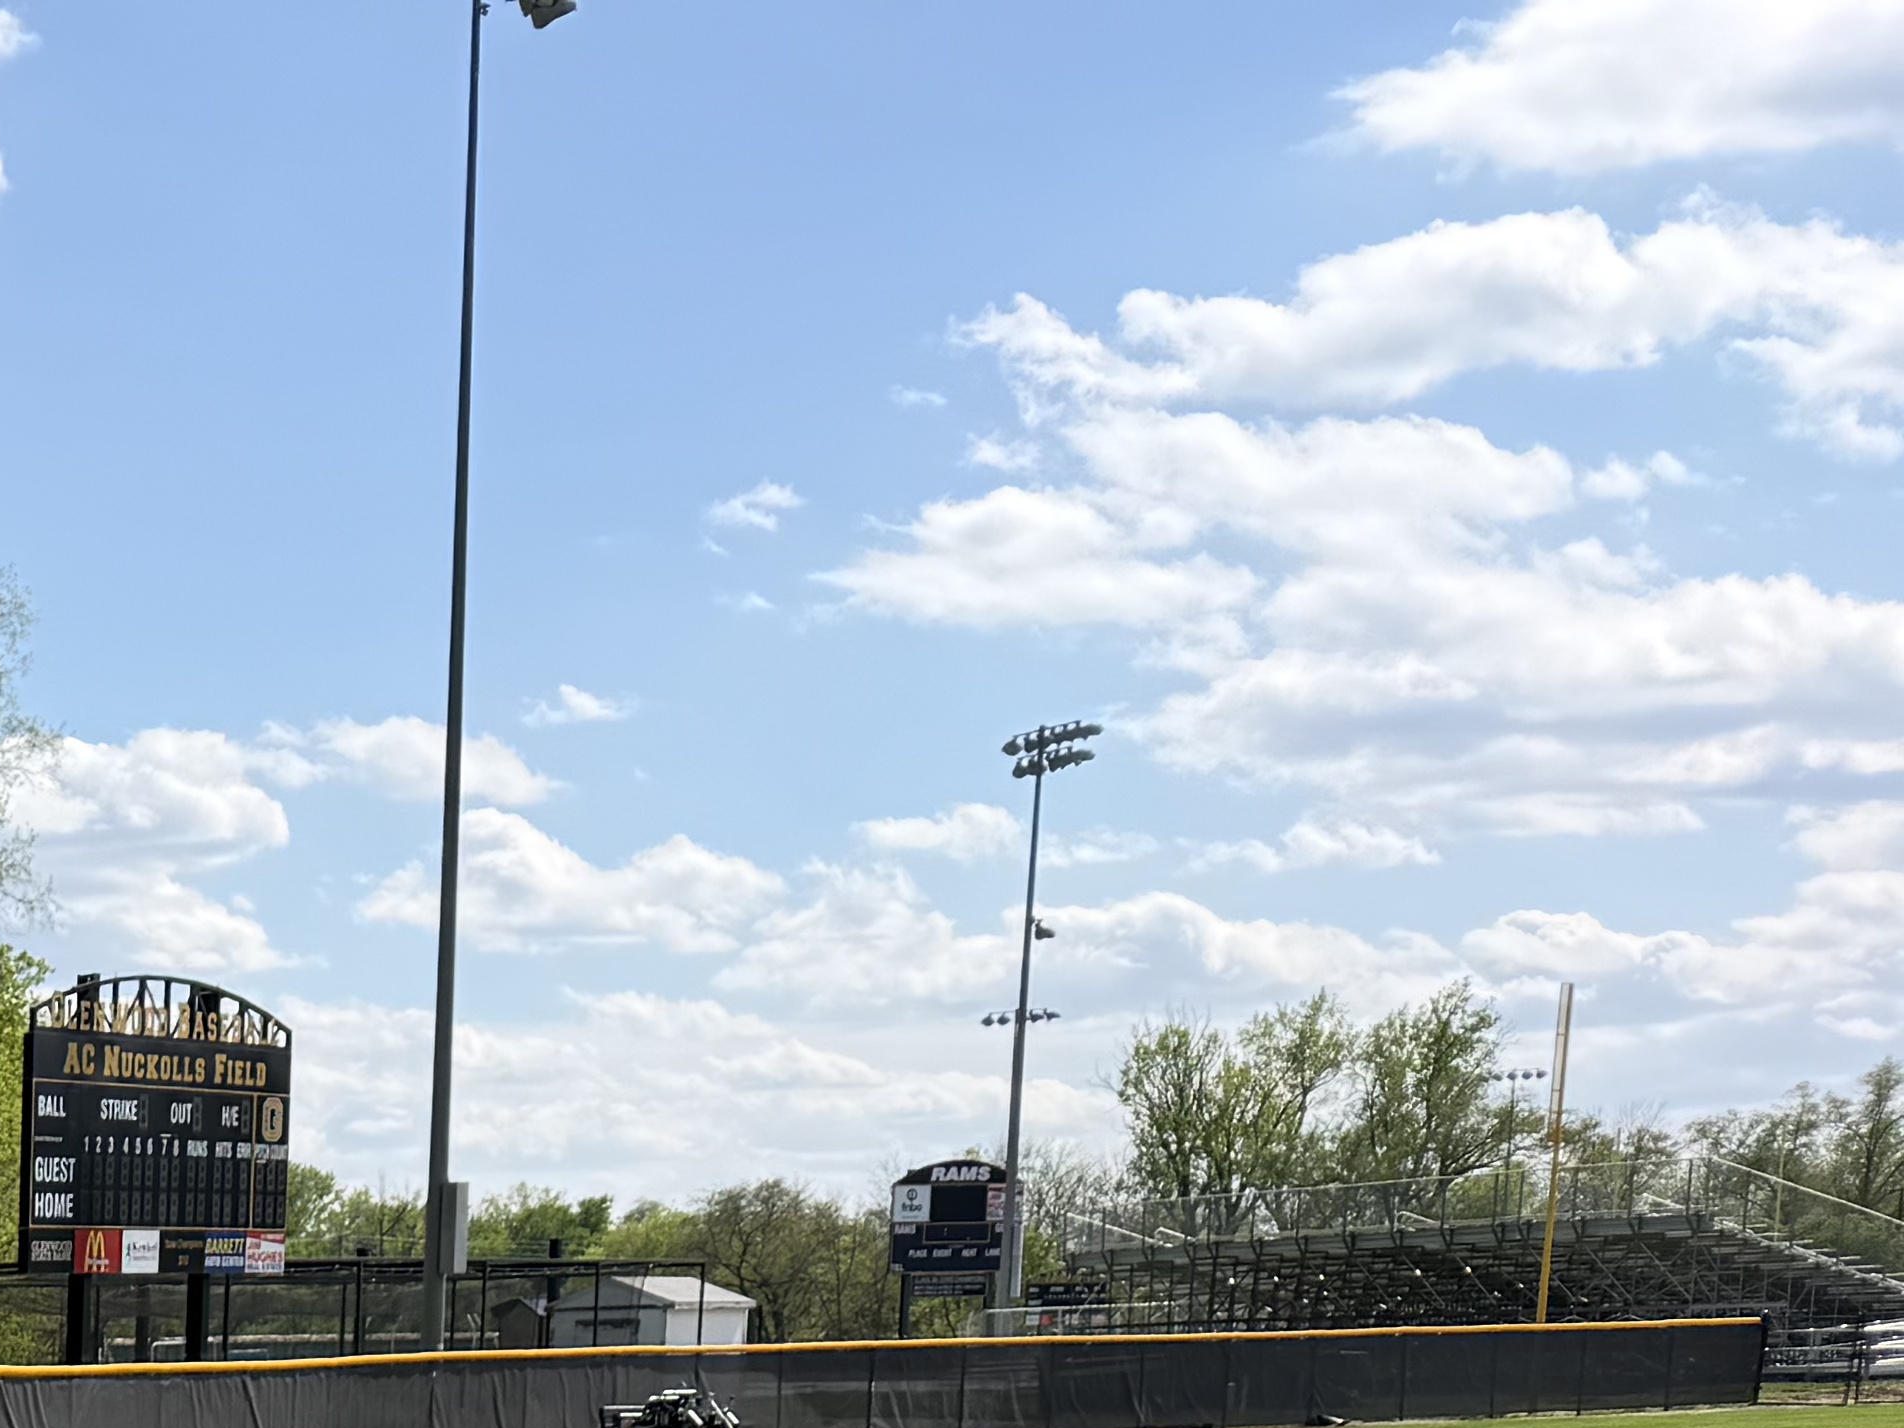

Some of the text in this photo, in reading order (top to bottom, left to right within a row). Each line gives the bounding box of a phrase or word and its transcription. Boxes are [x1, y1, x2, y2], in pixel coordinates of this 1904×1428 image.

[63, 1042, 267, 1088] AC NUCKOLLS FIELD
[37, 1094, 66, 1118] BALL
[100, 1098, 138, 1121] STRIKE
[170, 1102, 192, 1125] OUT
[221, 1105, 239, 1127] H/E
[95, 1136, 102, 1153] 2
[108, 1137, 114, 1154] 3
[122, 1136, 129, 1154] 4
[135, 1137, 142, 1155] 5
[146, 1138, 153, 1155] 6
[161, 1138, 168, 1155] 7
[34, 1157, 76, 1183] GUEST
[931, 1166, 991, 1181] RAMS
[34, 1192, 74, 1219] HOME
